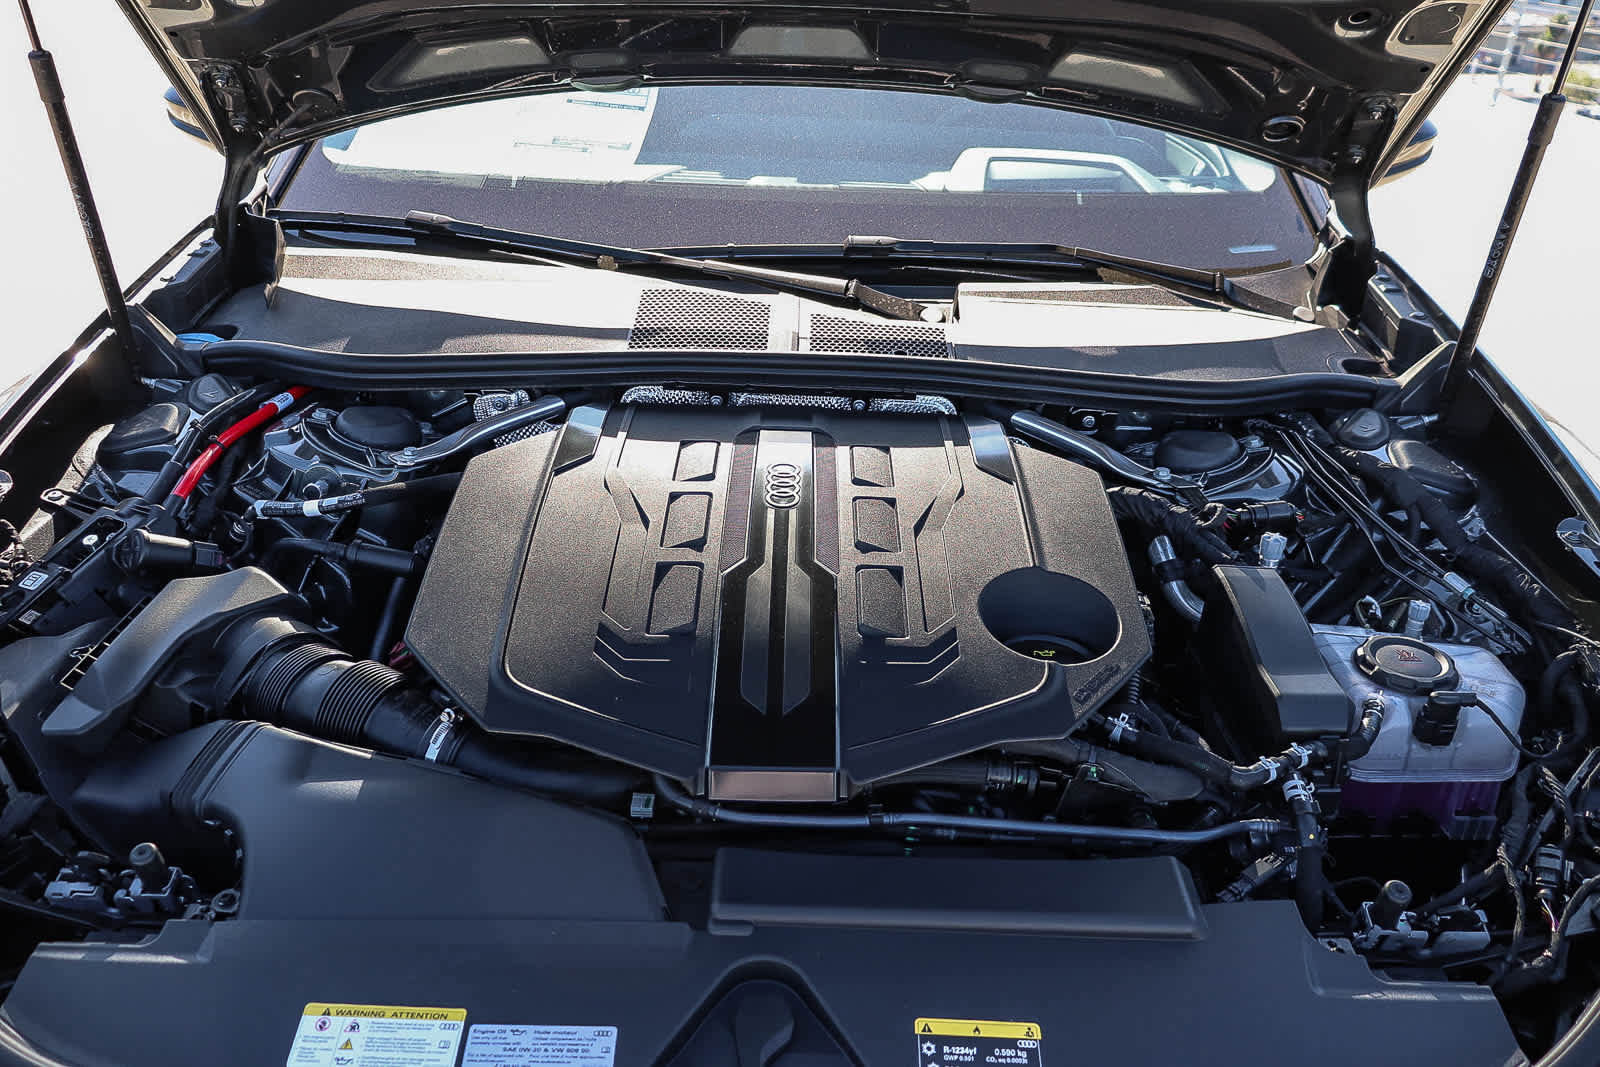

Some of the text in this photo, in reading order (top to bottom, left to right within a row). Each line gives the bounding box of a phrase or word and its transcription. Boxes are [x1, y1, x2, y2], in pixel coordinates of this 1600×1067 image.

[335, 1008, 449, 1020] WARNING ATTENTION
[1016, 1049, 1027, 1058] kg
